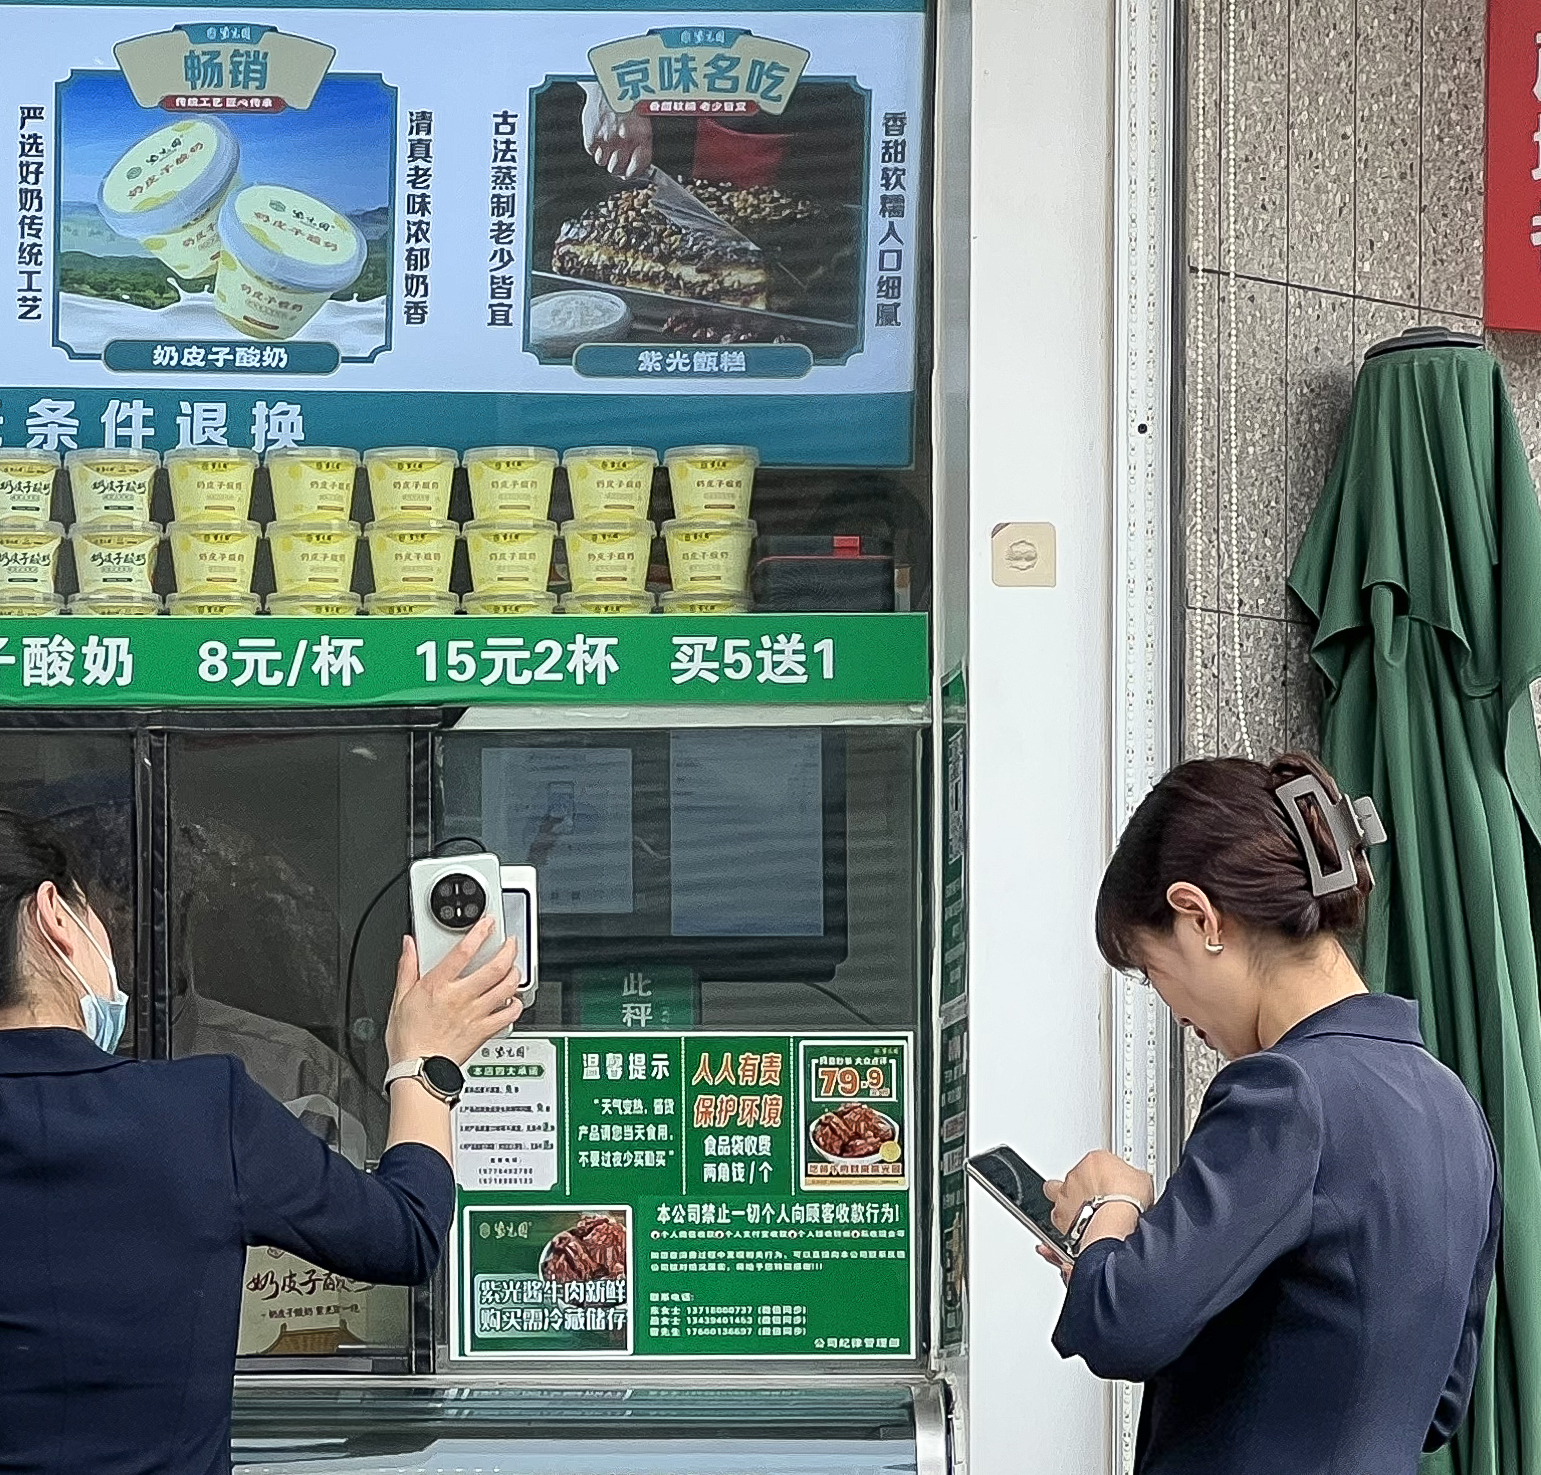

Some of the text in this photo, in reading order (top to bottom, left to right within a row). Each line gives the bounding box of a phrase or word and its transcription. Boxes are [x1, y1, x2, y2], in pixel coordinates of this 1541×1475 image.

[183, 48, 269, 91] 畅销
[610, 52, 791, 103] 京味名吃
[17, 105, 45, 322] 严选好奶传统工艺
[403, 110, 434, 326] 清真老味浓郁奶香
[486, 109, 520, 328] 古法蒸制老少皆宜
[152, 344, 289, 370] 奶皮子酸奶
[637, 351, 748, 374] 紫光甑糕
[196, 636, 365, 688] 8元/杯
[414, 633, 621, 686] 15元2杯
[670, 634, 836, 685] 买5送1
[581, 1052, 671, 1080] 温馨提示
[691, 1052, 783, 1087] 人人有责
[818, 1067, 885, 1097] 79.9
[693, 1094, 783, 1129] 保护环境
[703, 1135, 772, 1156] 食品袋收费
[703, 1161, 773, 1184] 两角钱/个
[656, 1202, 900, 1225] 本公司禁止一切个人向顾客收款行为！
[480, 1280, 627, 1304] 紫光酱牛肉新鲜
[479, 1306, 628, 1331] 购买需冷藏储存
